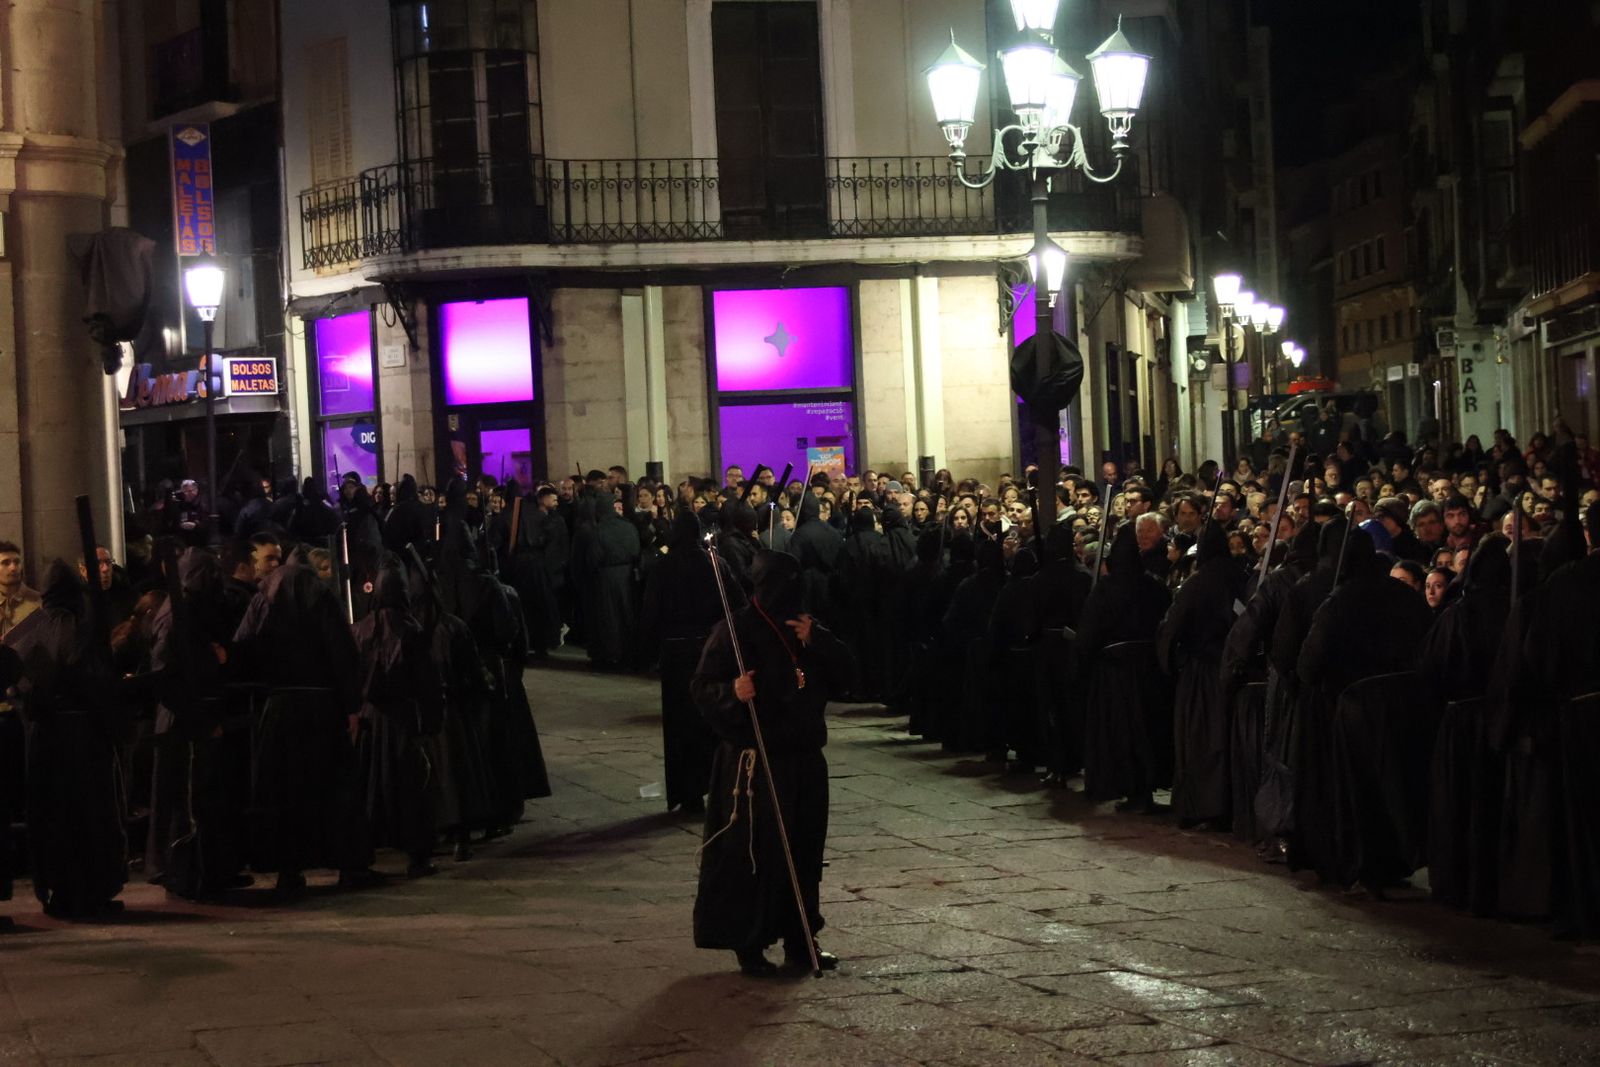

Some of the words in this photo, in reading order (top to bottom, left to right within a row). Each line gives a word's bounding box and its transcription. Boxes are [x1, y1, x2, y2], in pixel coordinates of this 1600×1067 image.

[176, 159, 196, 252] MALETAS
[195, 159, 213, 252] BOLSOS
[231, 379, 275, 391] MALETAS
[232, 364, 271, 375] BOLSOS
[1461, 358, 1478, 413] BAR
